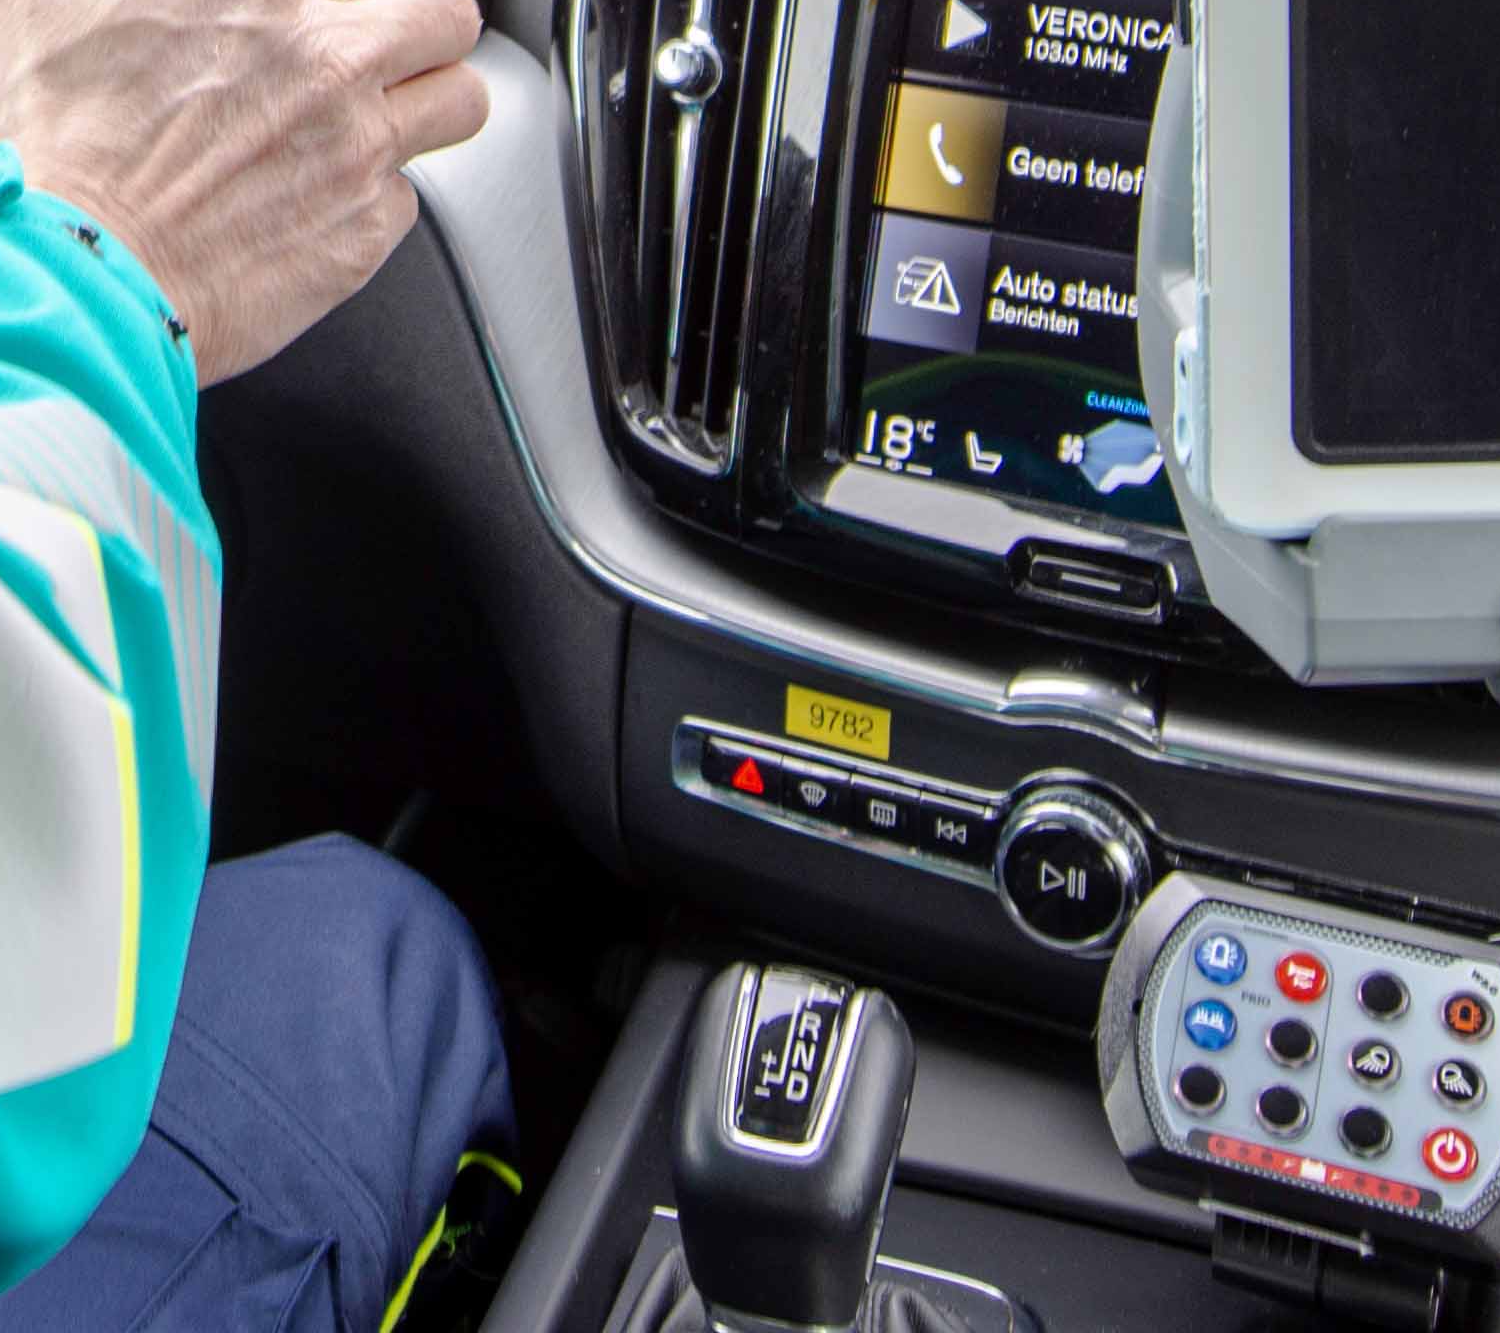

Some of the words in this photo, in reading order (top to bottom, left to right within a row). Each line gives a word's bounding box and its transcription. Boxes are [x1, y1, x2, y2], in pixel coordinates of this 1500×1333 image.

[1027, 2, 1176, 51] VERONICA
[1024, 36, 1080, 65] 103.0
[1082, 44, 1129, 74] MHz
[1007, 145, 1080, 186] Geen
[1085, 157, 1145, 195] telef
[992, 264, 1057, 303] Auto
[1060, 279, 1139, 319] status
[987, 296, 1081, 336] Berichten
[1086, 390, 1151, 417] CLEANZON
[810, 702, 874, 743] 9782
[799, 1010, 821, 1042] R
[792, 1039, 816, 1072] N
[786, 1069, 809, 1102] D
